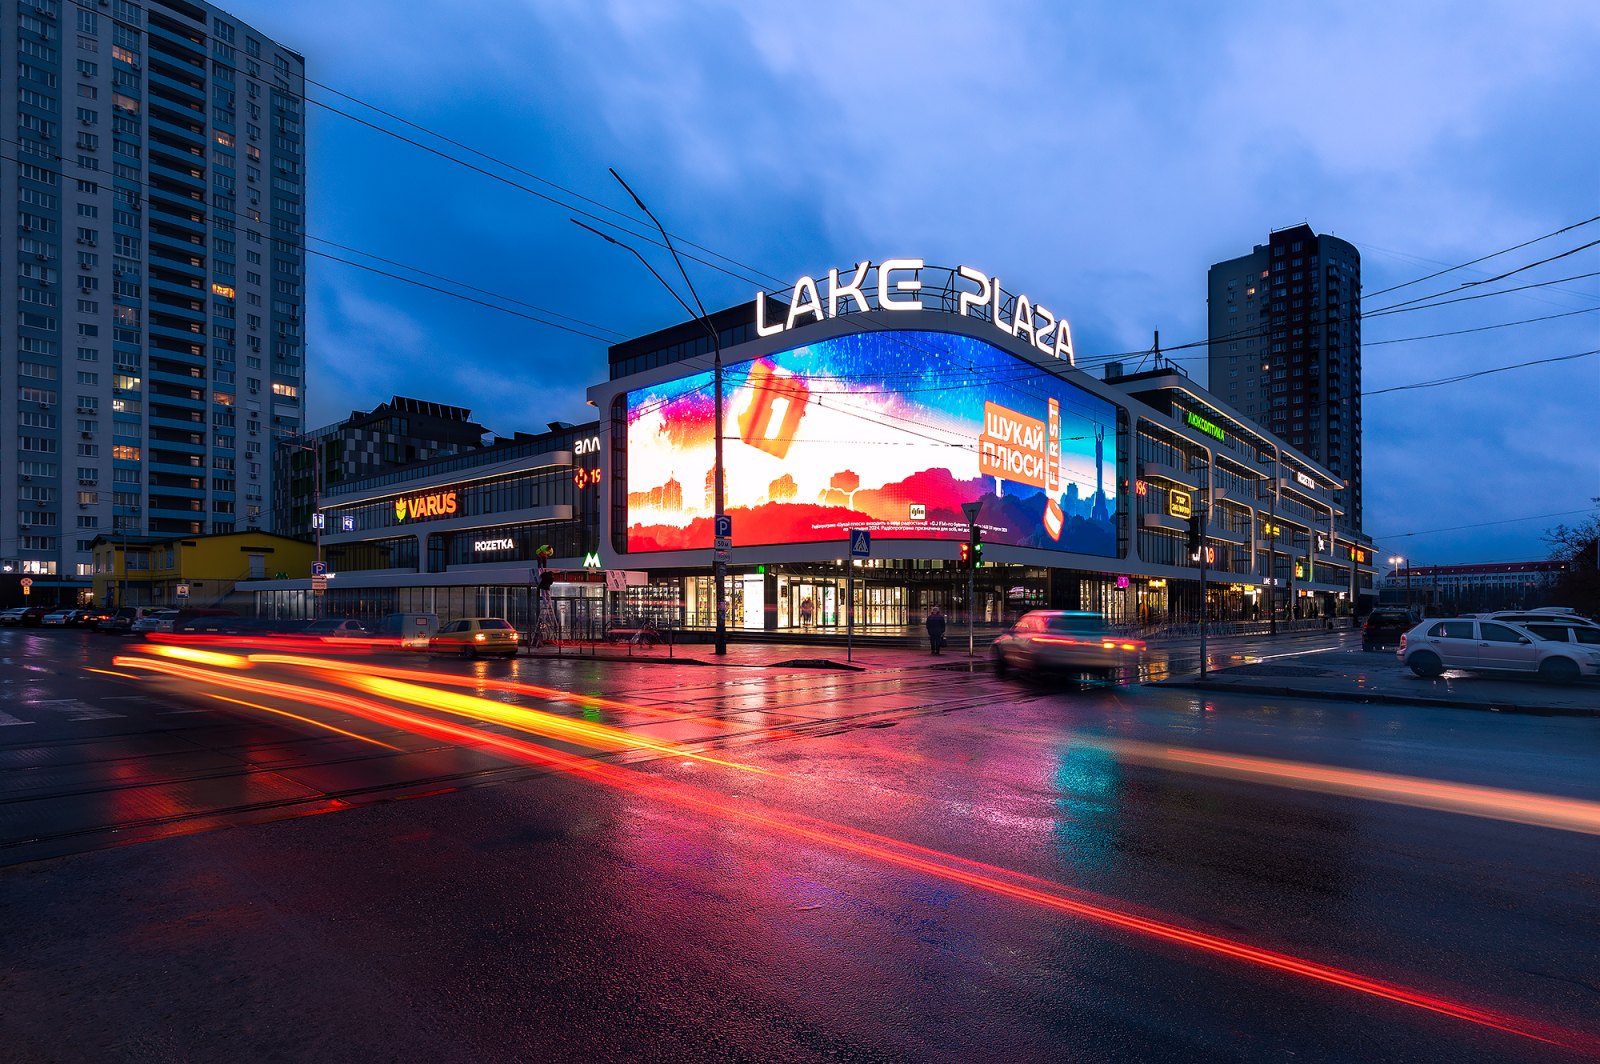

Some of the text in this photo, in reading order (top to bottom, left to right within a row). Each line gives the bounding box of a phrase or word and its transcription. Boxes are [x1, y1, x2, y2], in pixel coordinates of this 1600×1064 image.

[757, 259, 1075, 366] LAKE PLAZA
[987, 411, 1043, 453] ШУКАЙ
[1049, 403, 1059, 486] FIRST
[983, 441, 1043, 480] ПЛЮСИ
[408, 493, 457, 518] VARUS
[475, 538, 514, 552] ROZETKA
[720, 521, 728, 535] P
